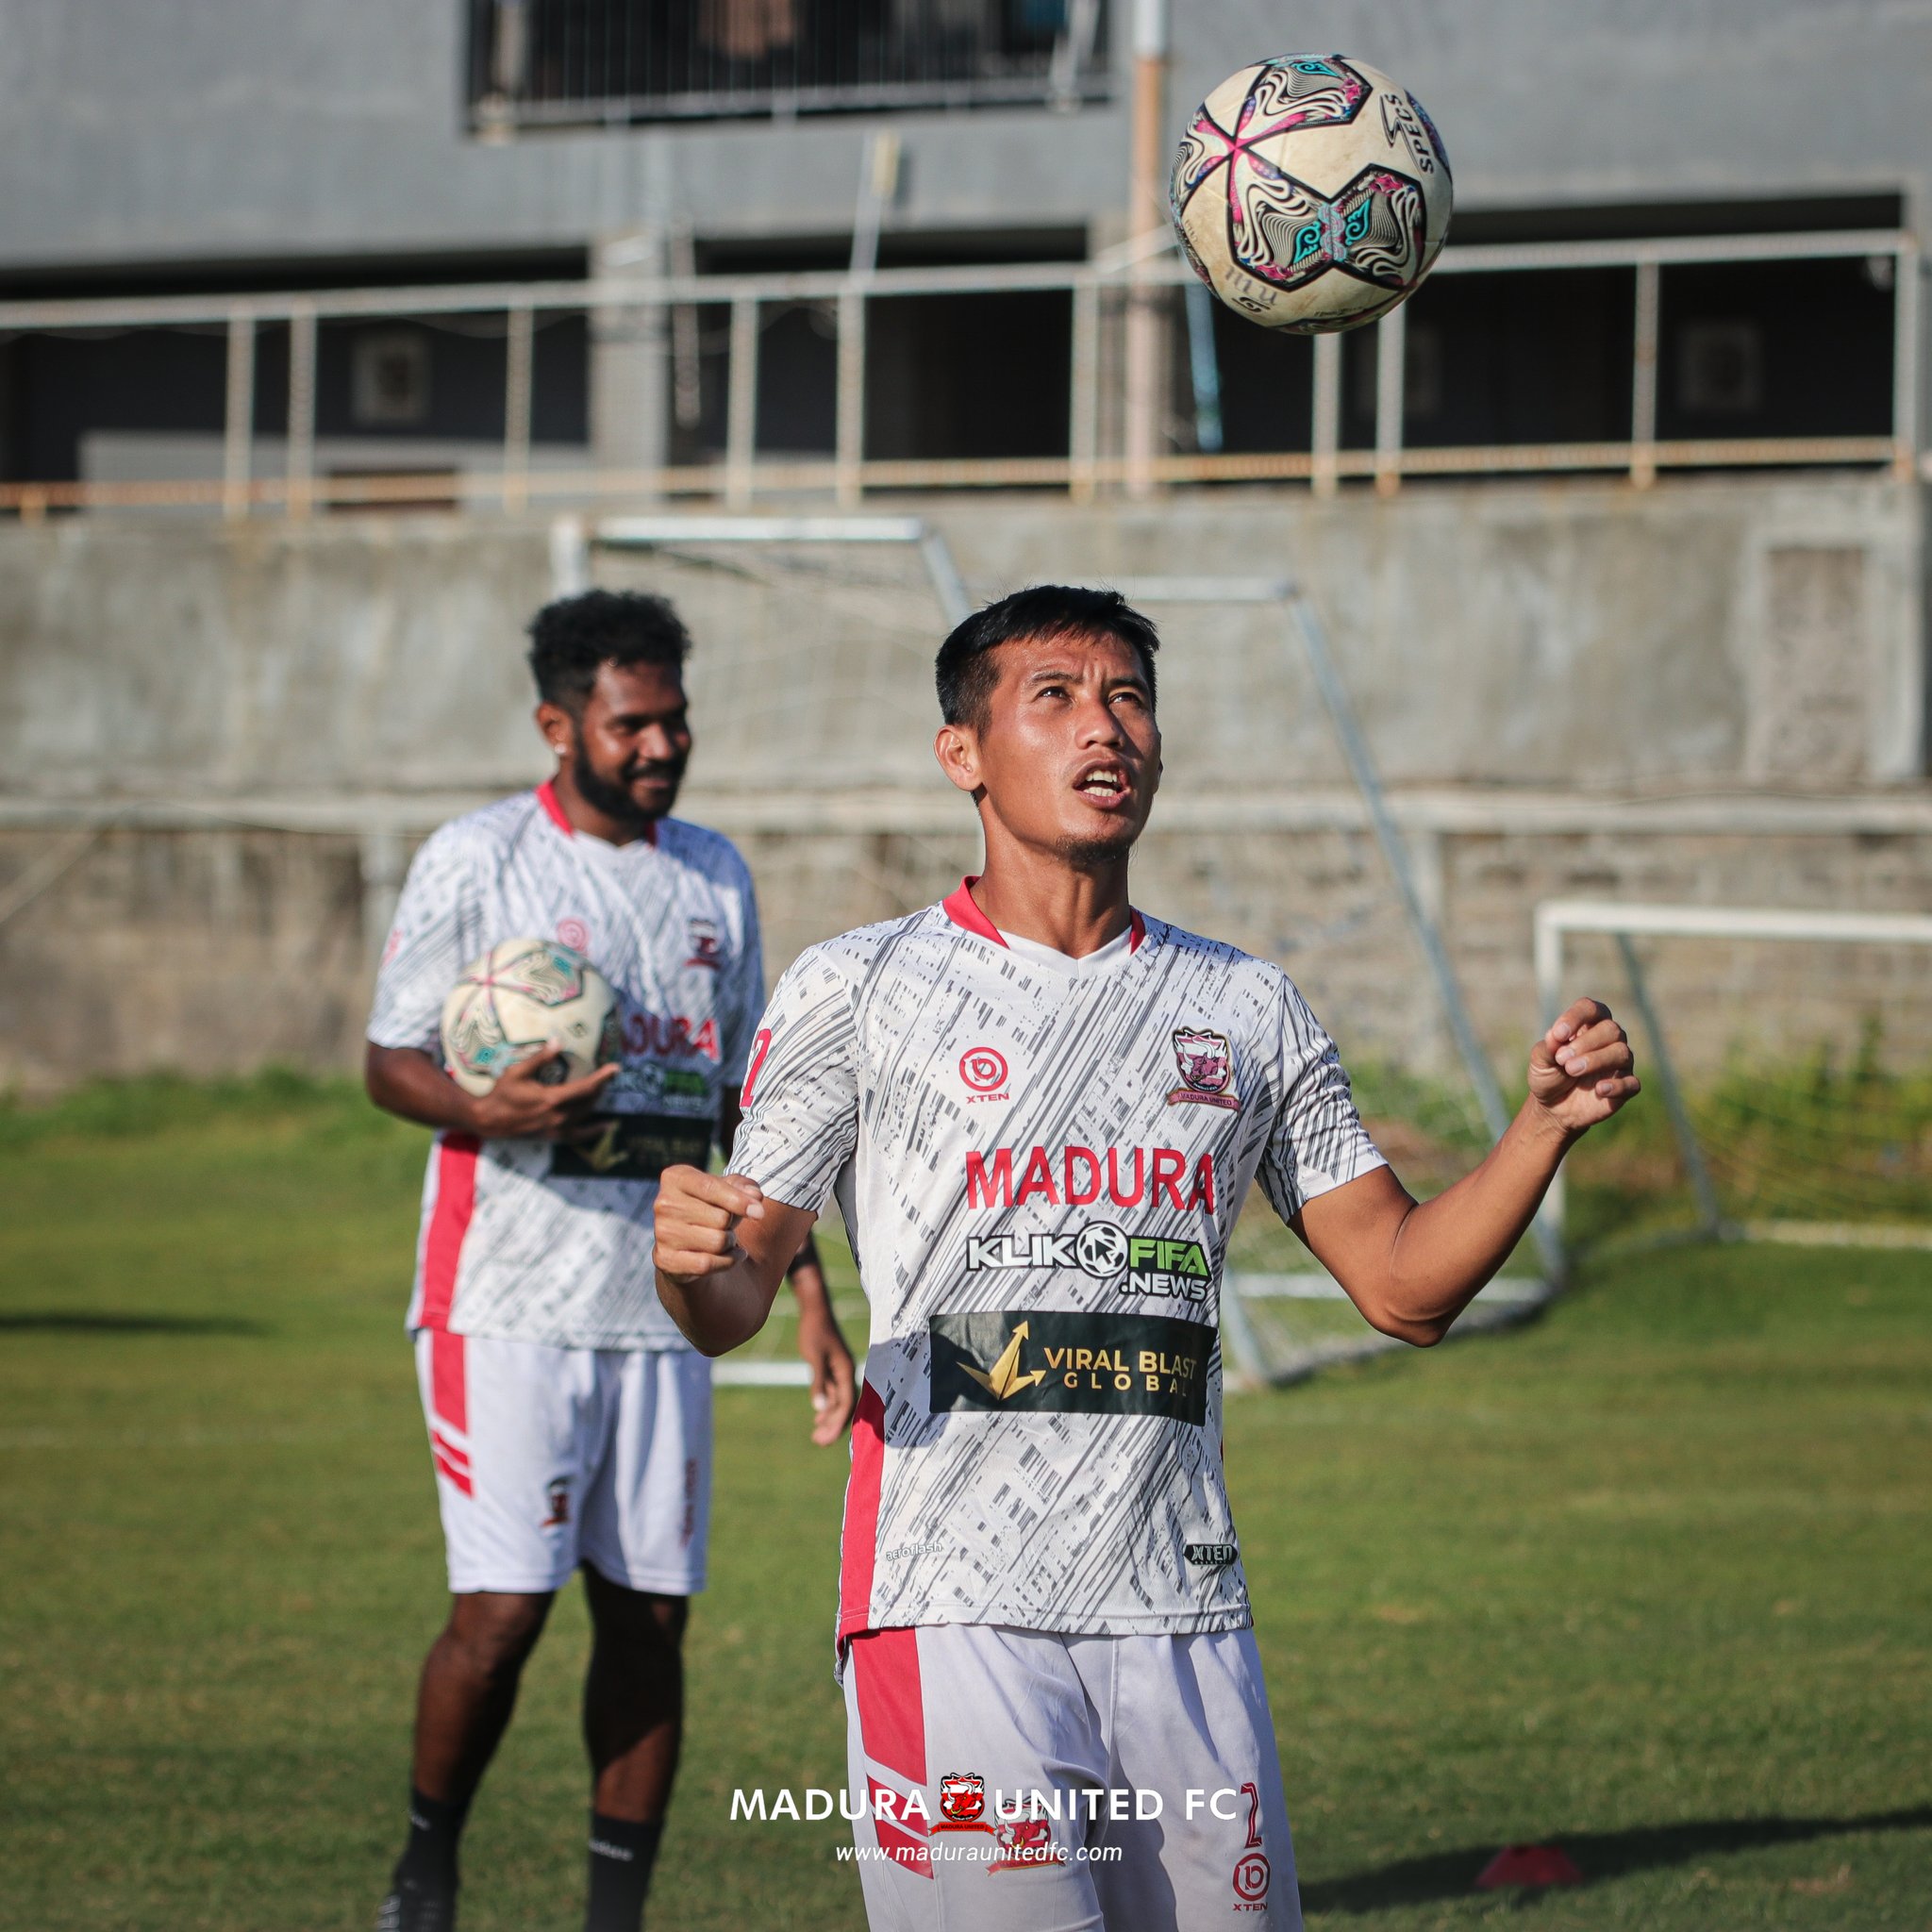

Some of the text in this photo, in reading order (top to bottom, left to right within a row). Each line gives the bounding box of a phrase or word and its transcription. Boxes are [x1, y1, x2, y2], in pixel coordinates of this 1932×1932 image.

[1384, 93, 1434, 175] SPECS
[966, 1092, 1009, 1104] XTEN
[1209, 1097, 1232, 1107] UNITED
[965, 1145, 1214, 1215] MADURA
[1121, 1273, 1208, 1299] .NEWS
[1043, 1347, 1197, 1380] VIRAL BLAST
[1064, 1372, 1187, 1397] GLOBAL
[1191, 1545, 1233, 1561] XTEN
[1233, 1903, 1268, 1912] XTEN
